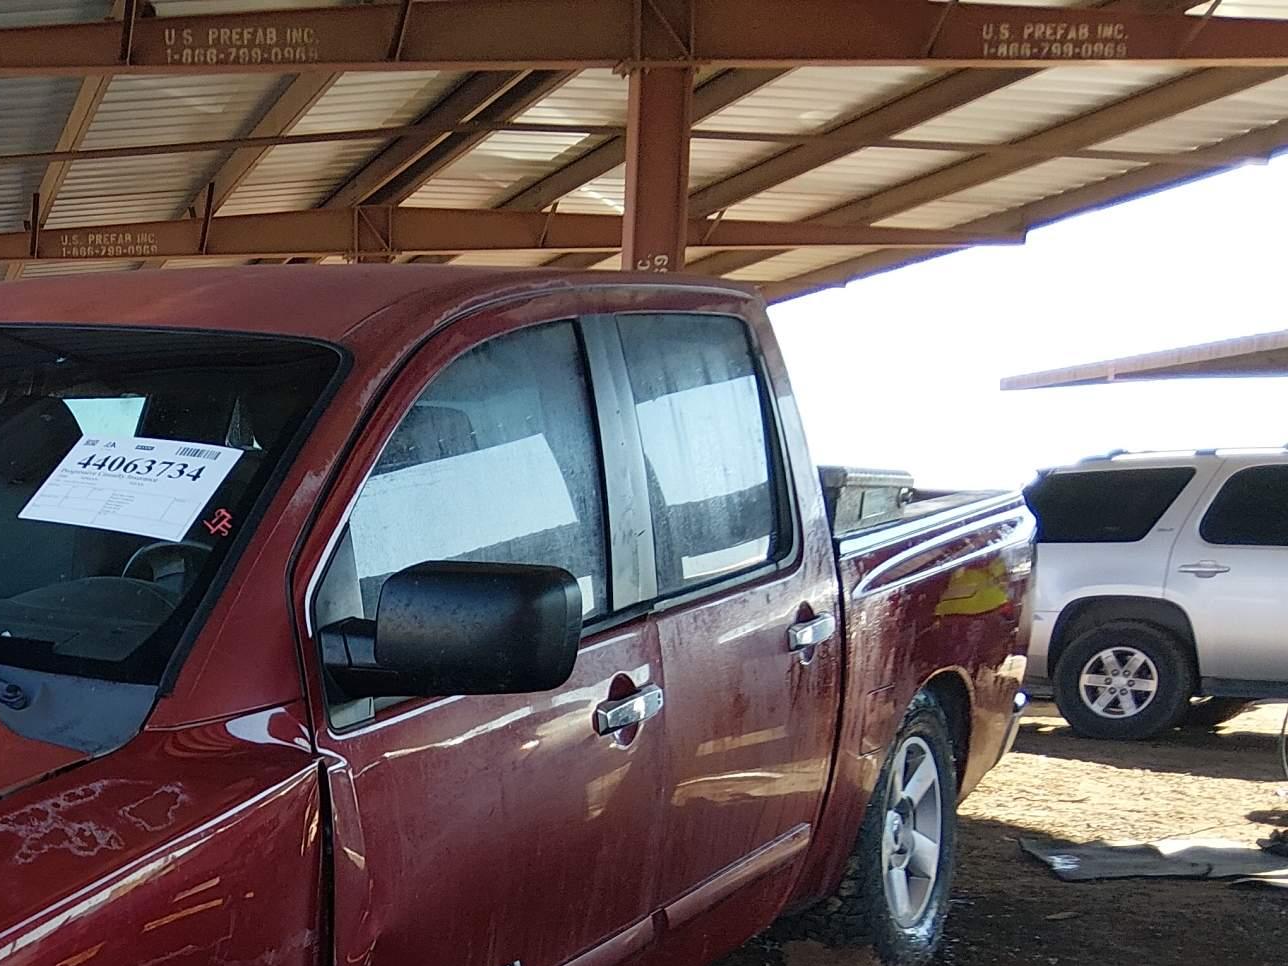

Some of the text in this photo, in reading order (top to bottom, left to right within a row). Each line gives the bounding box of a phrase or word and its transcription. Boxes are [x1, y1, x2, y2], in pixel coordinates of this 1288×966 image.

[208, 27, 277, 45] PREFAB
[286, 27, 320, 45] INC.
[1023, 22, 1089, 40] PREFAB
[1097, 23, 1129, 40] INC.
[88, 232, 132, 245] PREFAB
[137, 232, 159, 244] INC.
[77, 453, 206, 482] 44063734
